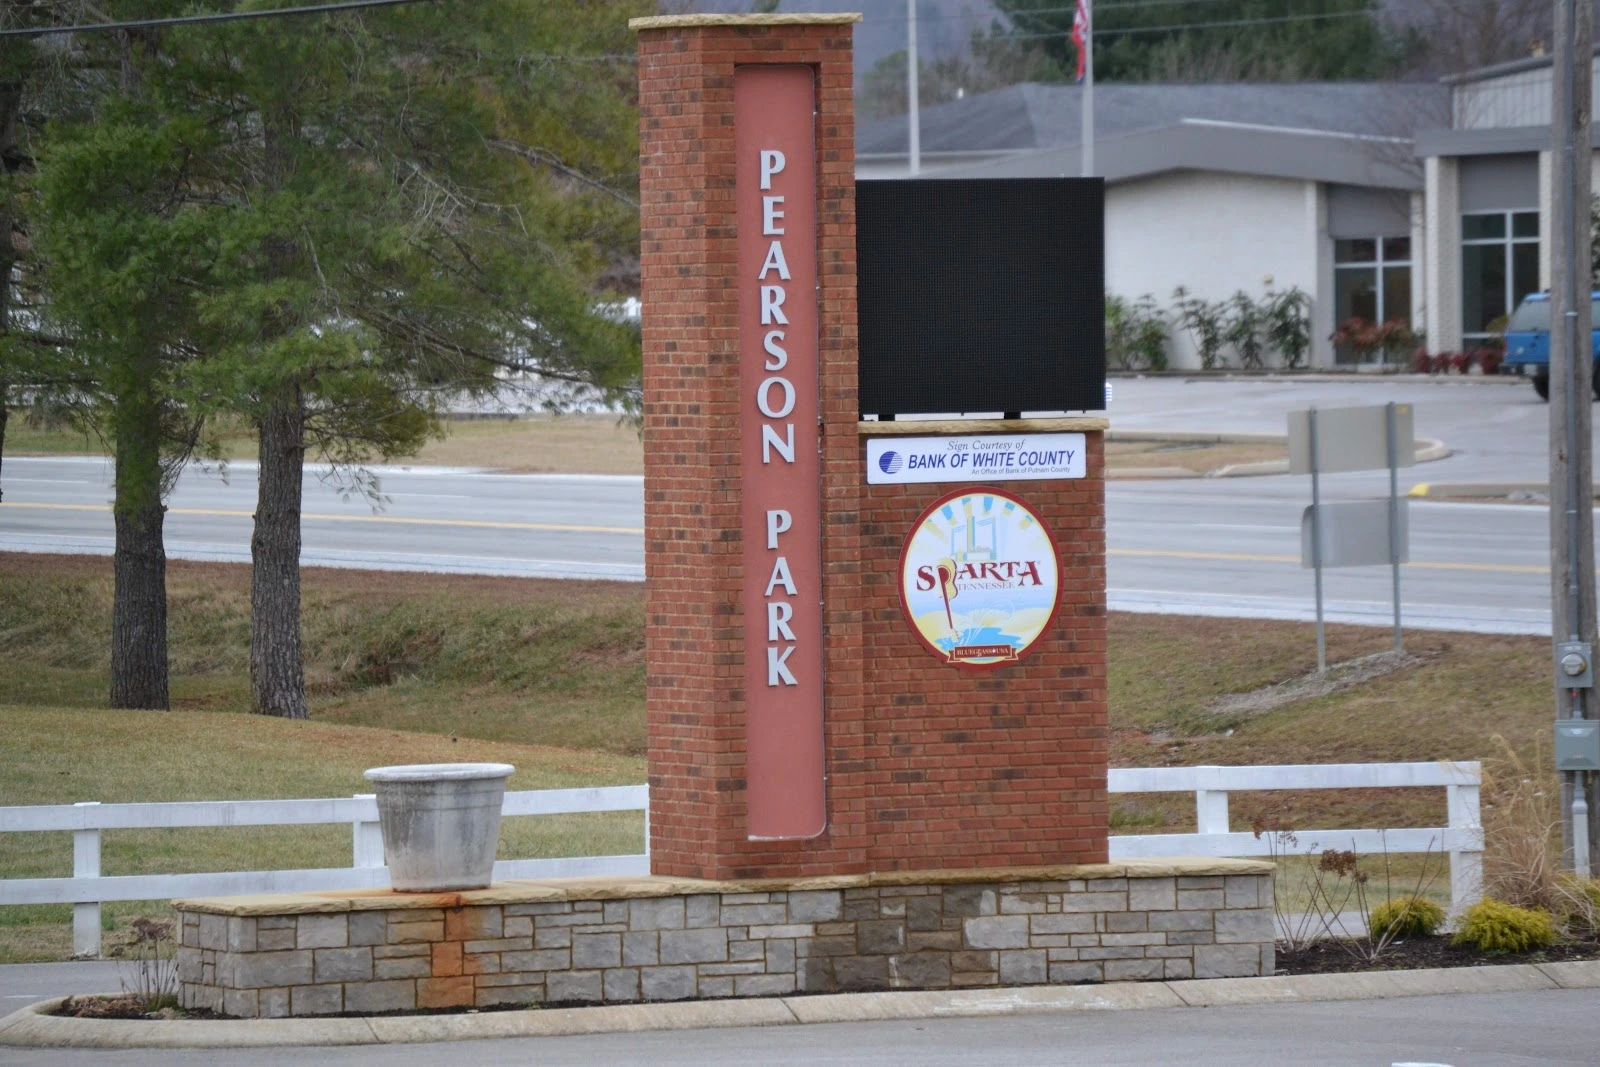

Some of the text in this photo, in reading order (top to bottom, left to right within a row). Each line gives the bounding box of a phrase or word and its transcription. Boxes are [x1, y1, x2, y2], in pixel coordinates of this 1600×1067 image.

[756, 149, 799, 687] PEARSON PARK
[947, 439, 1026, 452] Sign Courtesy of
[908, 450, 1075, 469] BANK OF WHITE COUNTY
[1050, 466, 1071, 474] County
[957, 582, 1016, 591] TENNESSEE
